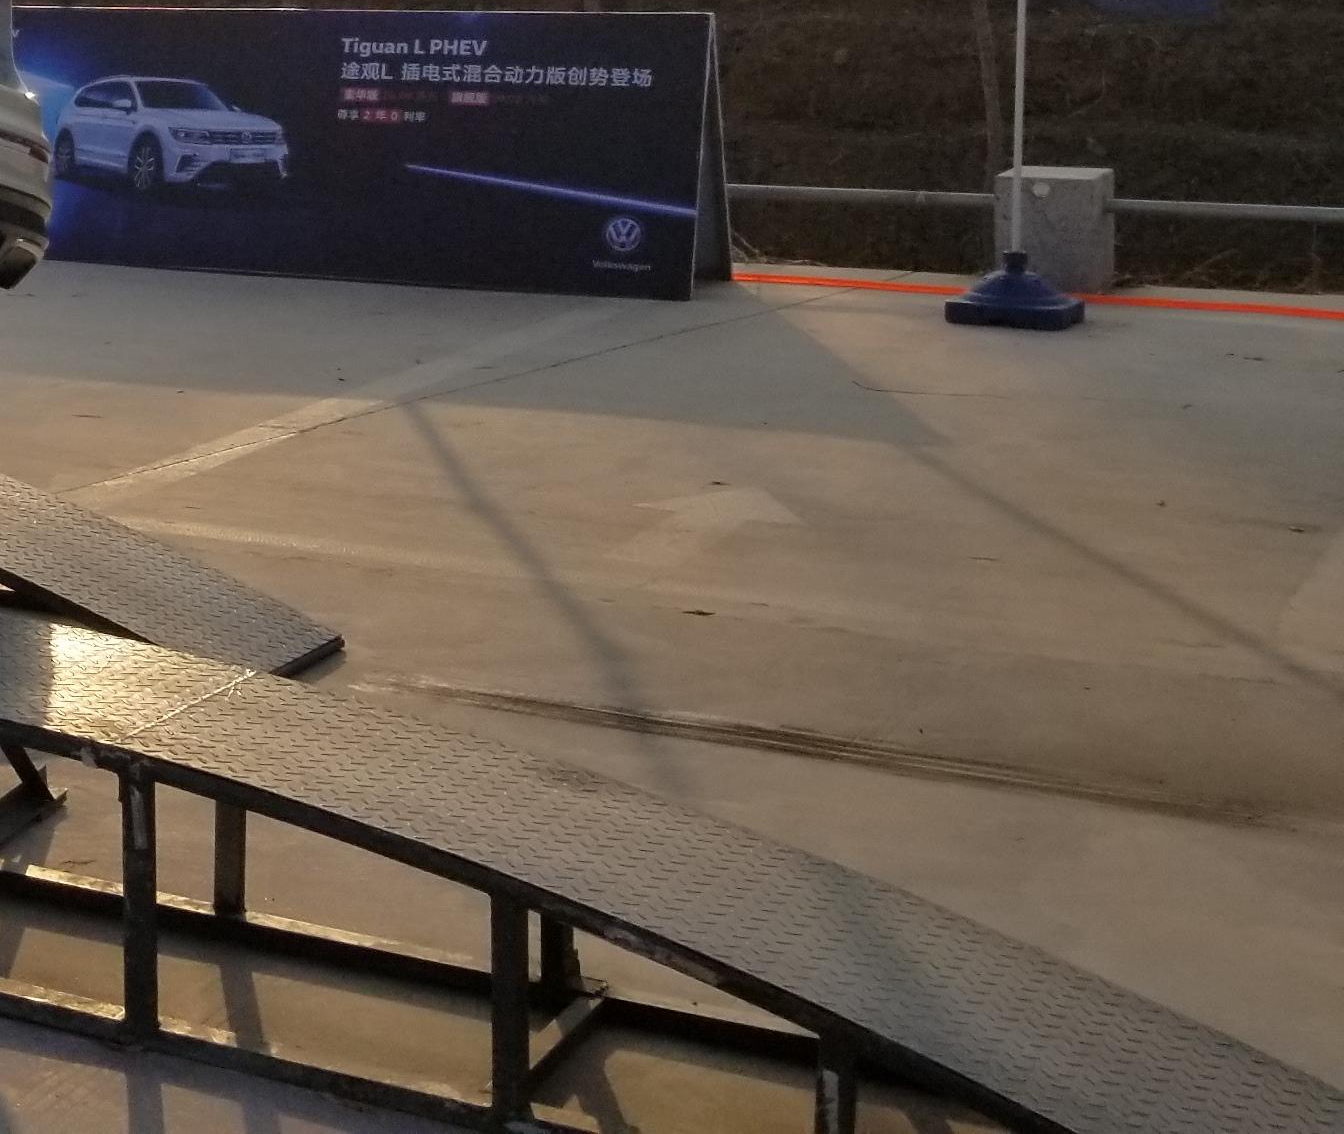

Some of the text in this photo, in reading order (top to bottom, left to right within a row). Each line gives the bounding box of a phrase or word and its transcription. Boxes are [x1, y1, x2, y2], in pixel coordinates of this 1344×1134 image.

[341, 37, 488, 57] Tiguan L PHEV
[340, 62, 393, 80] 途观L
